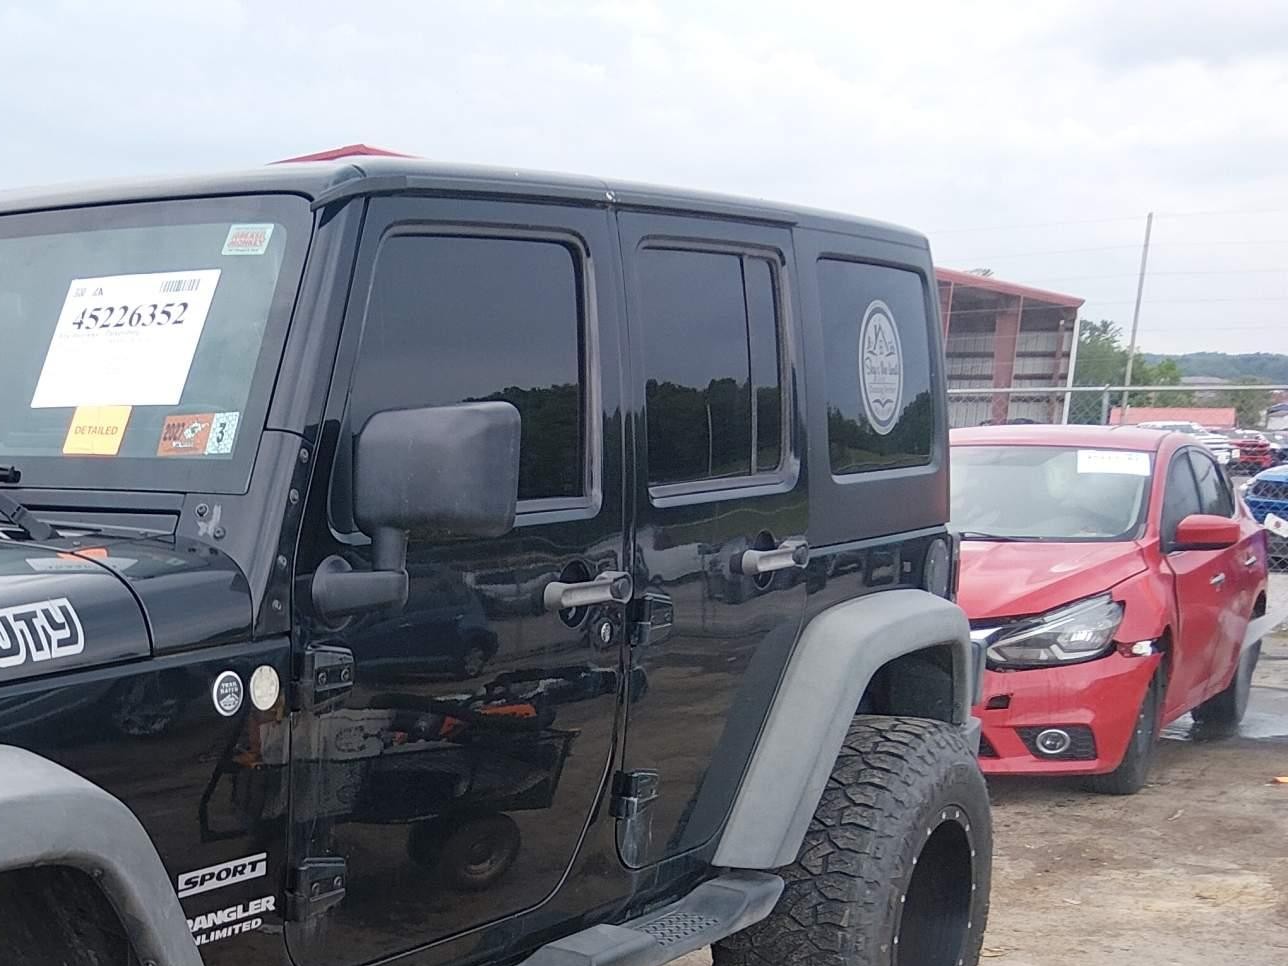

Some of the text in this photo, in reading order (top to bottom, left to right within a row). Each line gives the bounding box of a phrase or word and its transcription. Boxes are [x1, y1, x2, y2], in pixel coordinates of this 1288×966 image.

[72, 302, 189, 330] 45226352
[74, 425, 119, 436] DETAILED
[217, 422, 227, 443] 3
[184, 860, 261, 889] SPORT
[193, 918, 263, 946] NLIMITED
